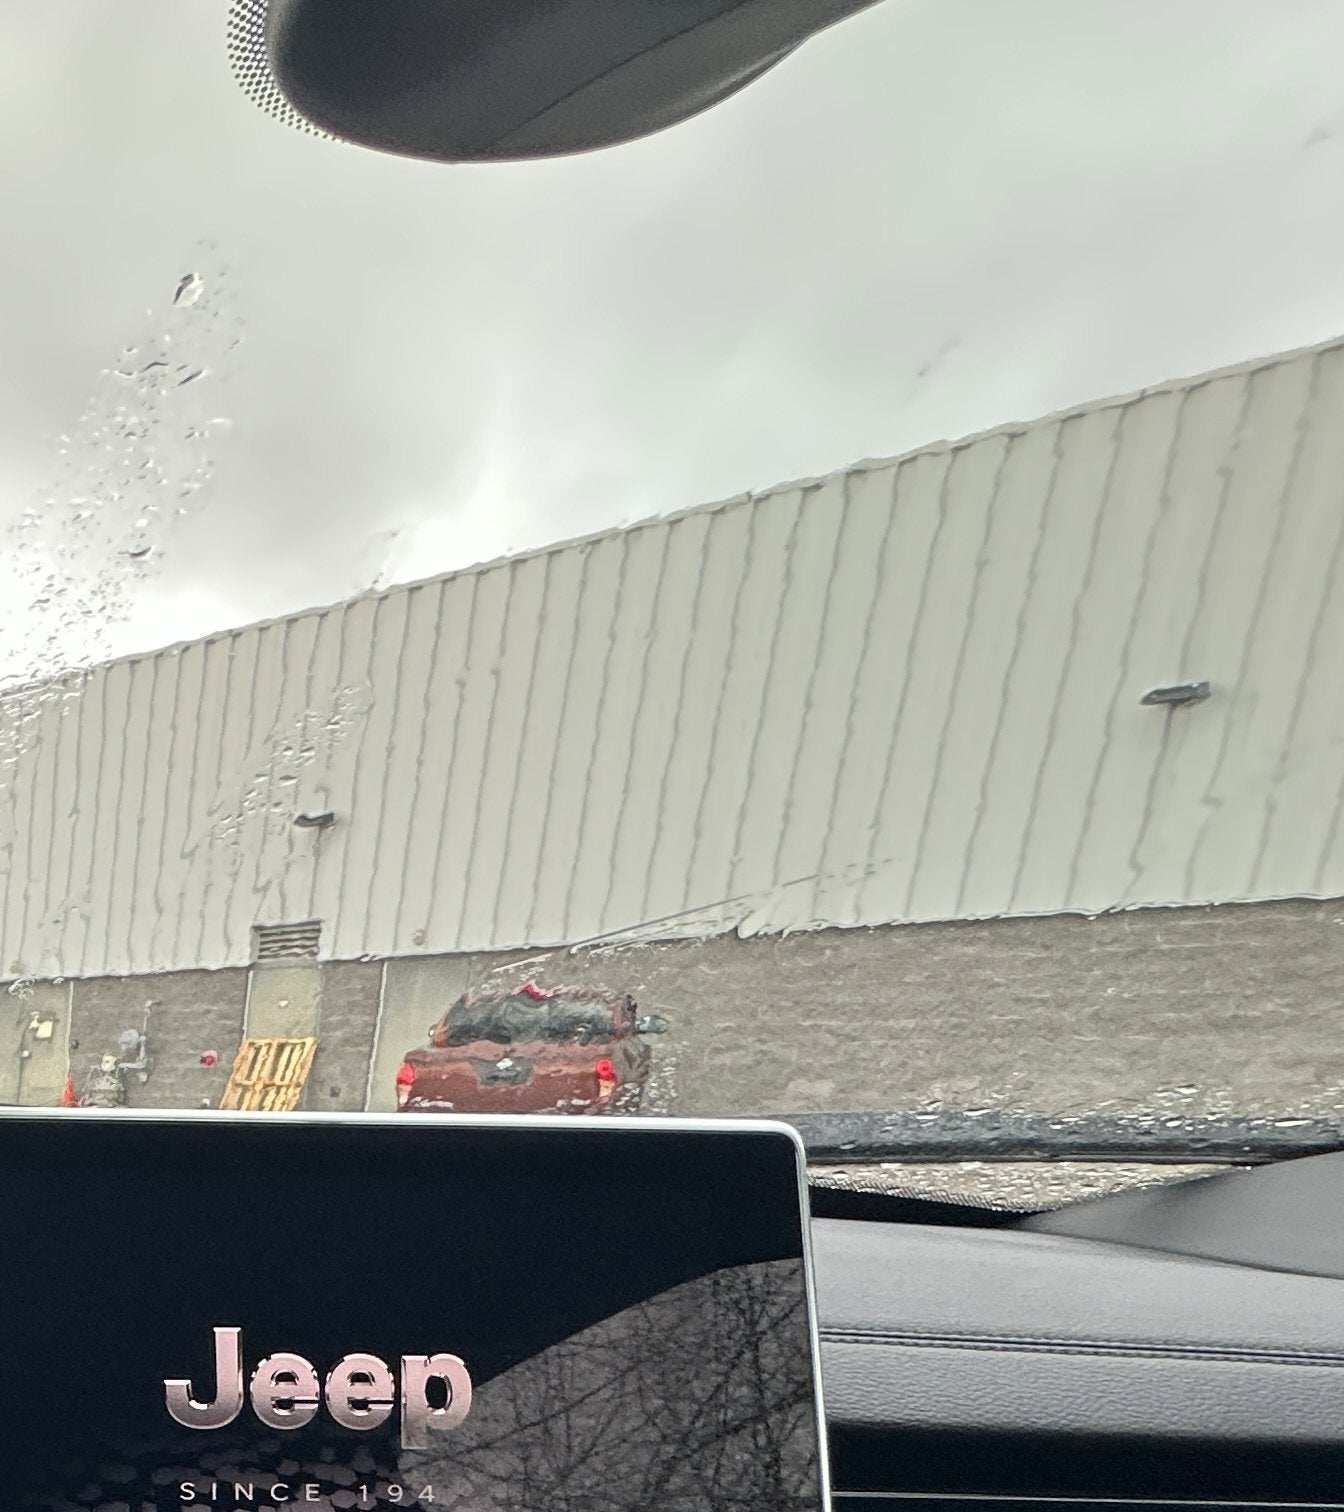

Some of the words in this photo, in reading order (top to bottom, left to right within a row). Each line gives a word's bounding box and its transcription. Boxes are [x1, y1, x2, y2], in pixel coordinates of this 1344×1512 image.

[163, 1325, 473, 1450] Jeep
[179, 1482, 321, 1502] SINCE
[359, 1484, 436, 1503] 194
